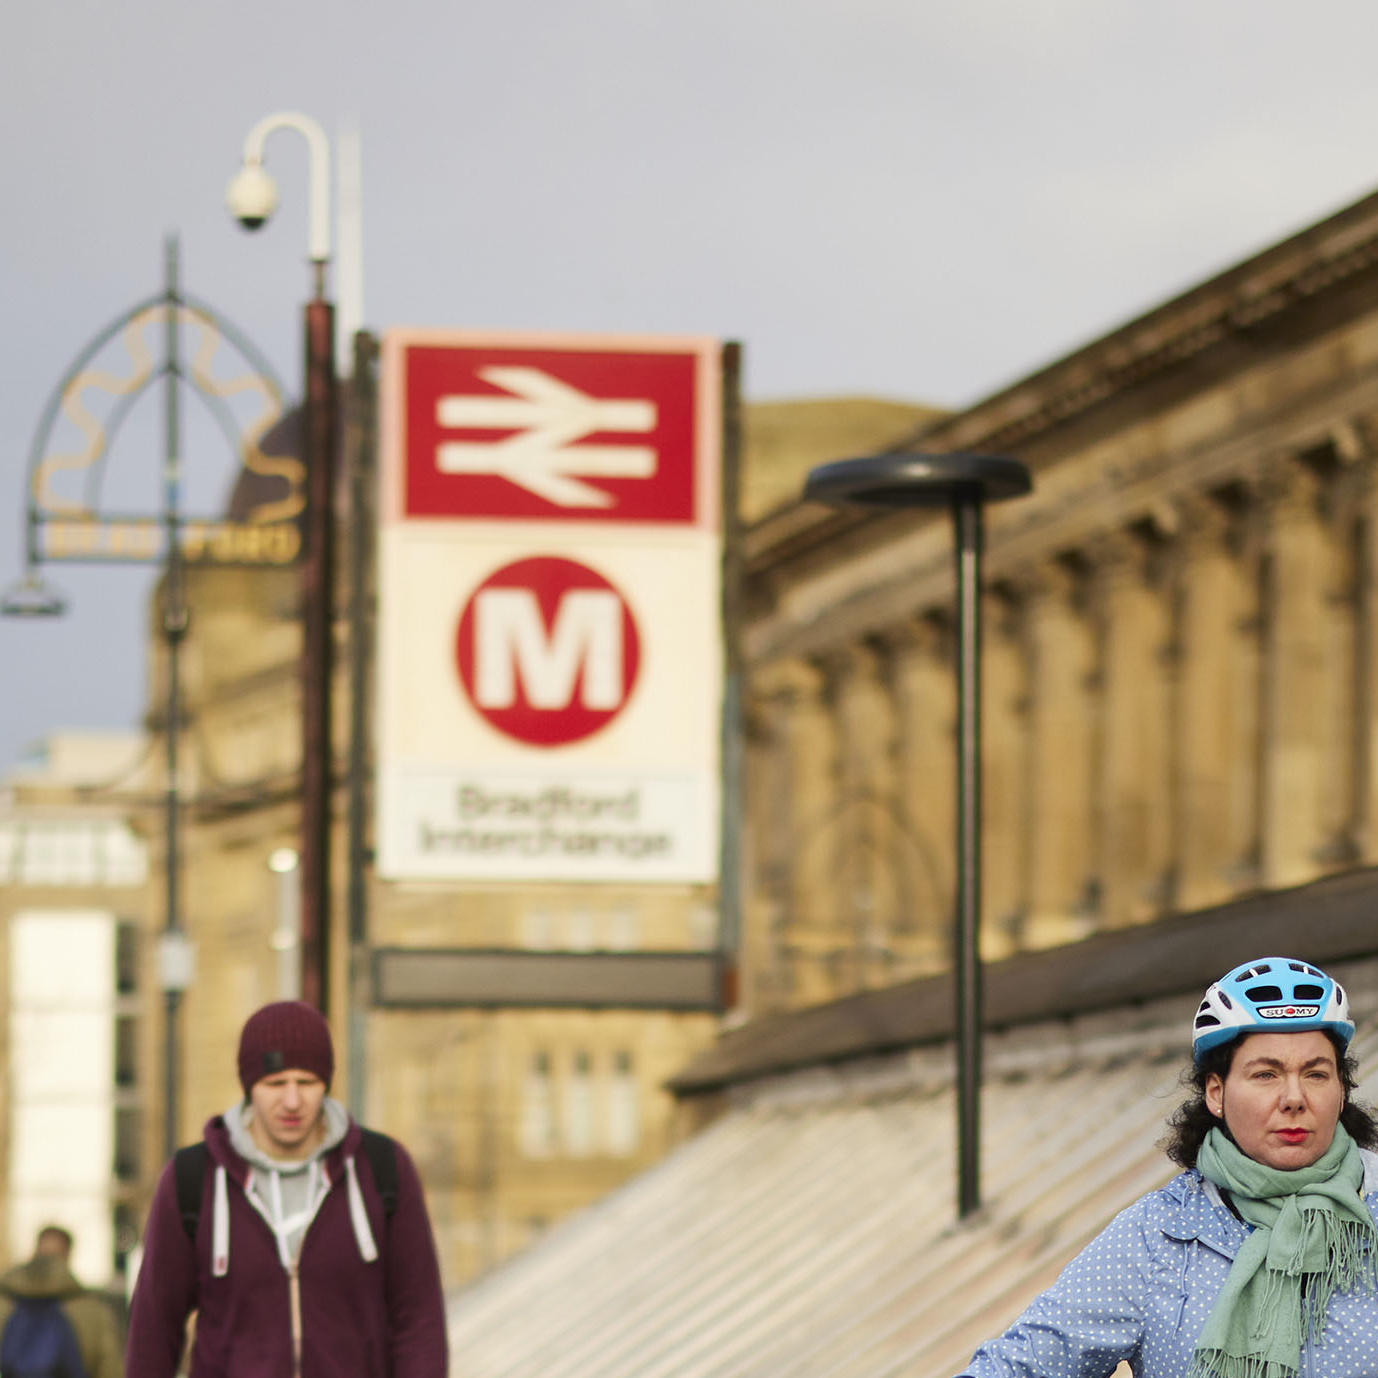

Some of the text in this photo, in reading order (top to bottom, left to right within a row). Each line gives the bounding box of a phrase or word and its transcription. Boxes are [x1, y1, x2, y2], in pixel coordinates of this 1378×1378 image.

[473, 588, 626, 711] M
[456, 783, 640, 821] Bradford
[418, 822, 672, 860] Interchange
